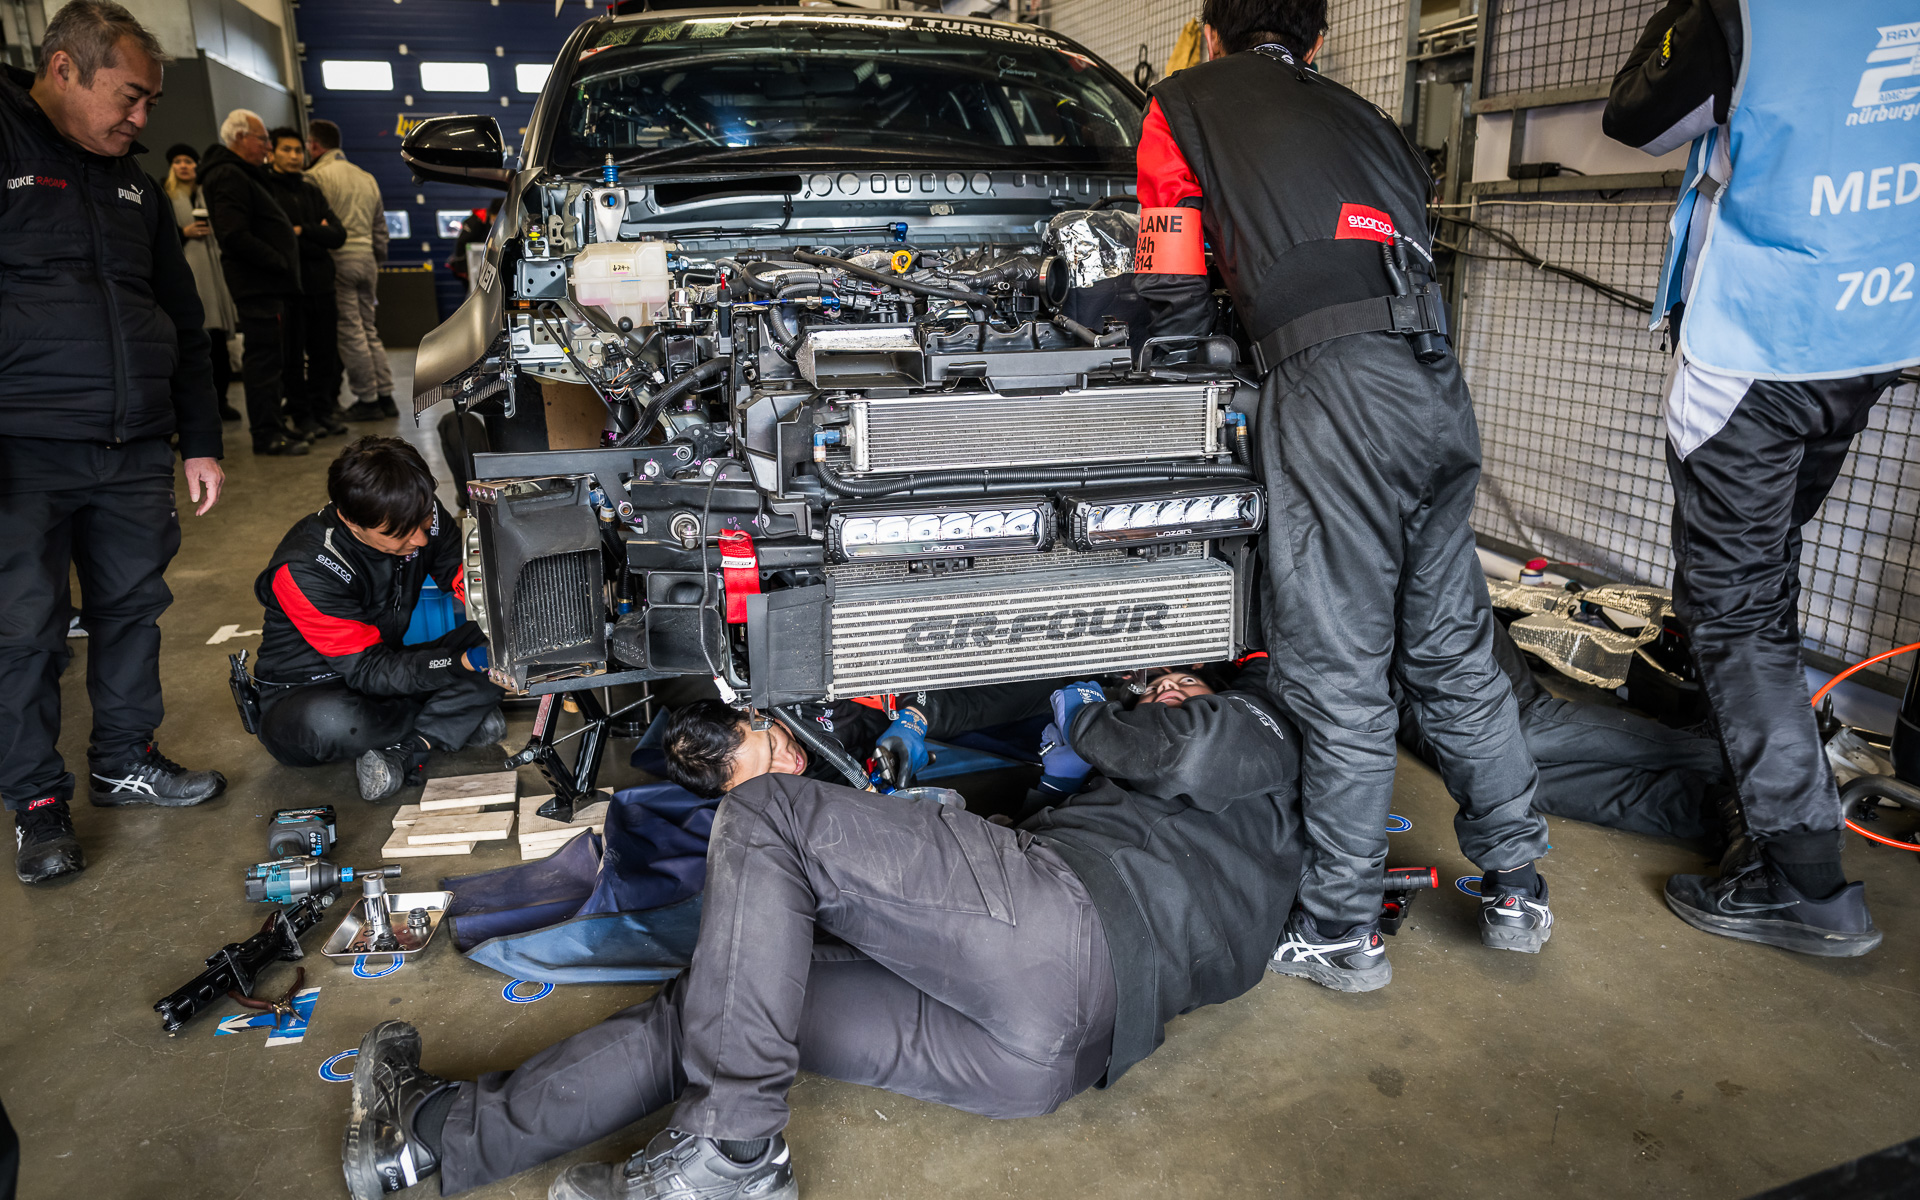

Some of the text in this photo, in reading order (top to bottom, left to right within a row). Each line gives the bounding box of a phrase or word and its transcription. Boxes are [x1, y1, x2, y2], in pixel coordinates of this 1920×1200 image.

[909, 26, 972, 36] DRIVING
[976, 33, 1061, 50] SIMULATOR
[1810, 162, 1920, 217] MED
[1141, 215, 1183, 233] LANE
[1348, 215, 1393, 235] sparco
[1835, 262, 1915, 311] 702
[316, 554, 352, 584] sparco
[903, 602, 1169, 654] GR-FOUR
